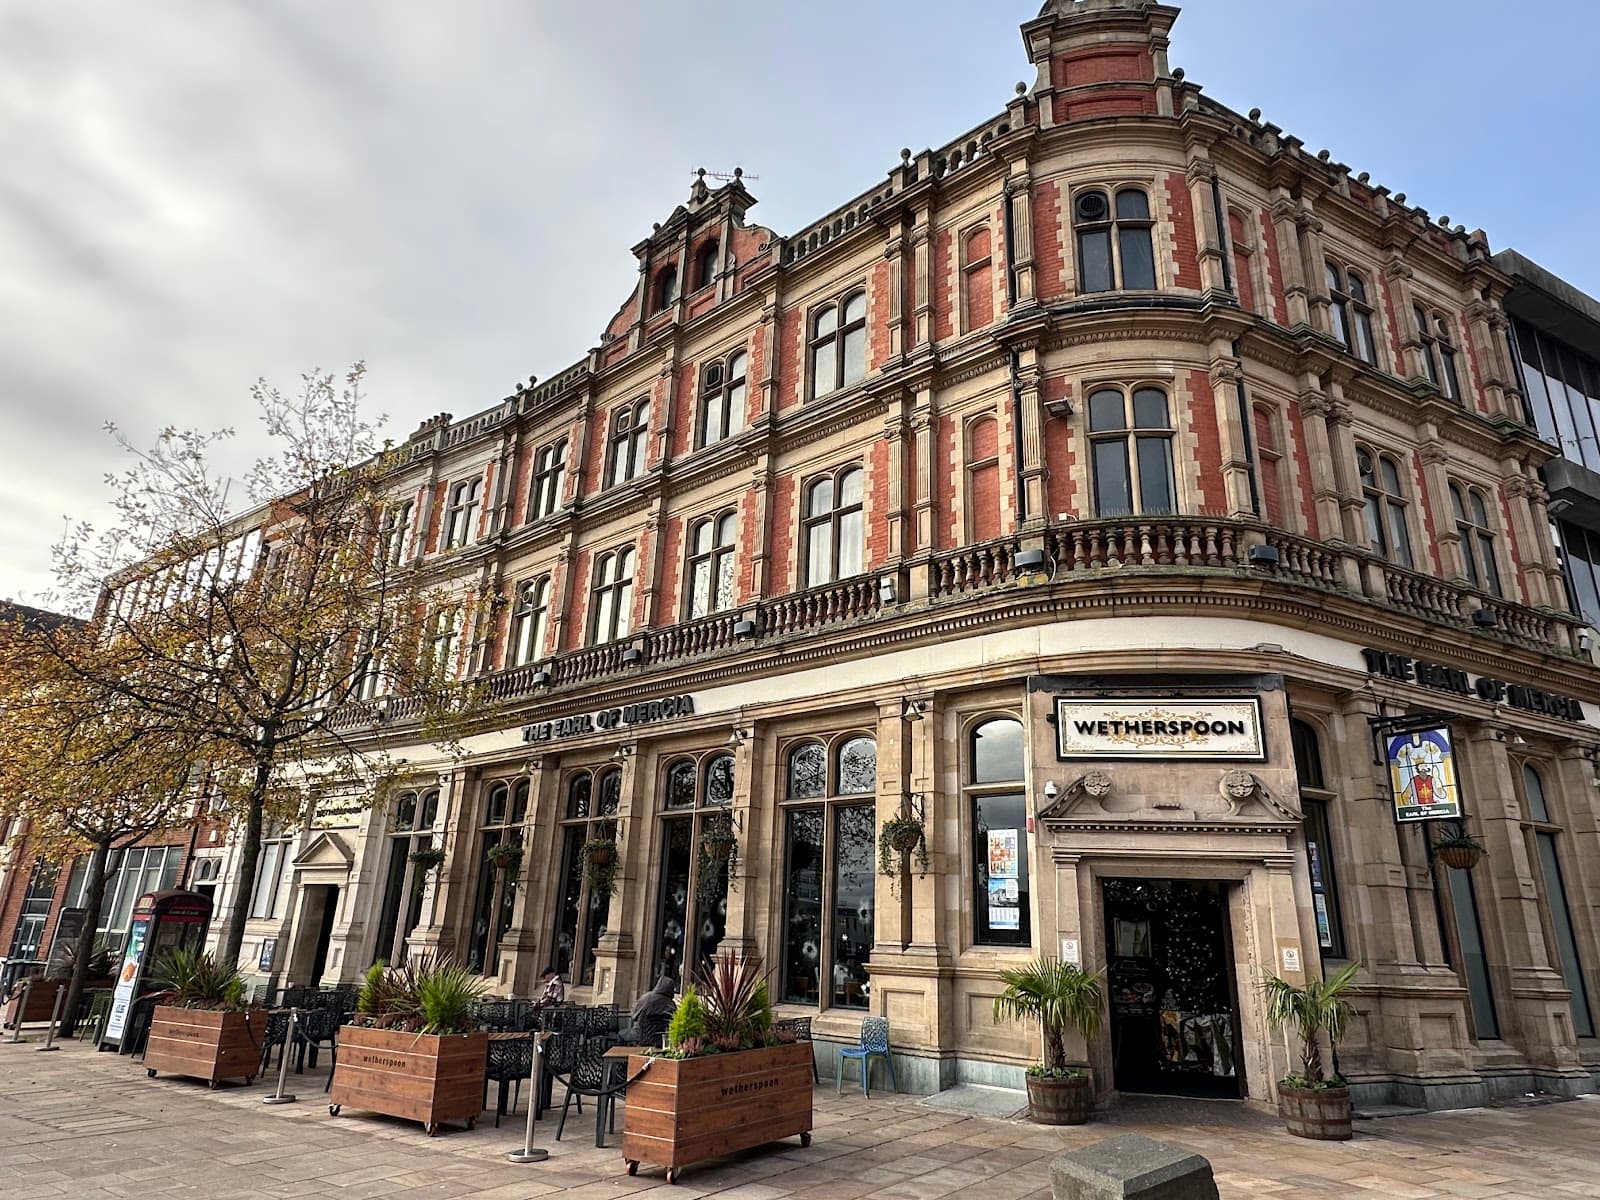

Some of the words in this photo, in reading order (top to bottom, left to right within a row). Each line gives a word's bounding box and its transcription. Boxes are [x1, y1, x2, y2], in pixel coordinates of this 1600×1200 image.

[1362, 647, 1415, 680] THE
[1416, 661, 1476, 694] EARL
[1475, 677, 1506, 701] OF
[521, 723, 550, 742] THE
[552, 714, 594, 737] EARL
[596, 708, 622, 729] OF
[623, 694, 695, 724] MERCIA
[1073, 719, 1245, 736] WETHERSPOON
[363, 1055, 406, 1068] wetherspoon
[720, 1078, 779, 1097] wetherspoon
